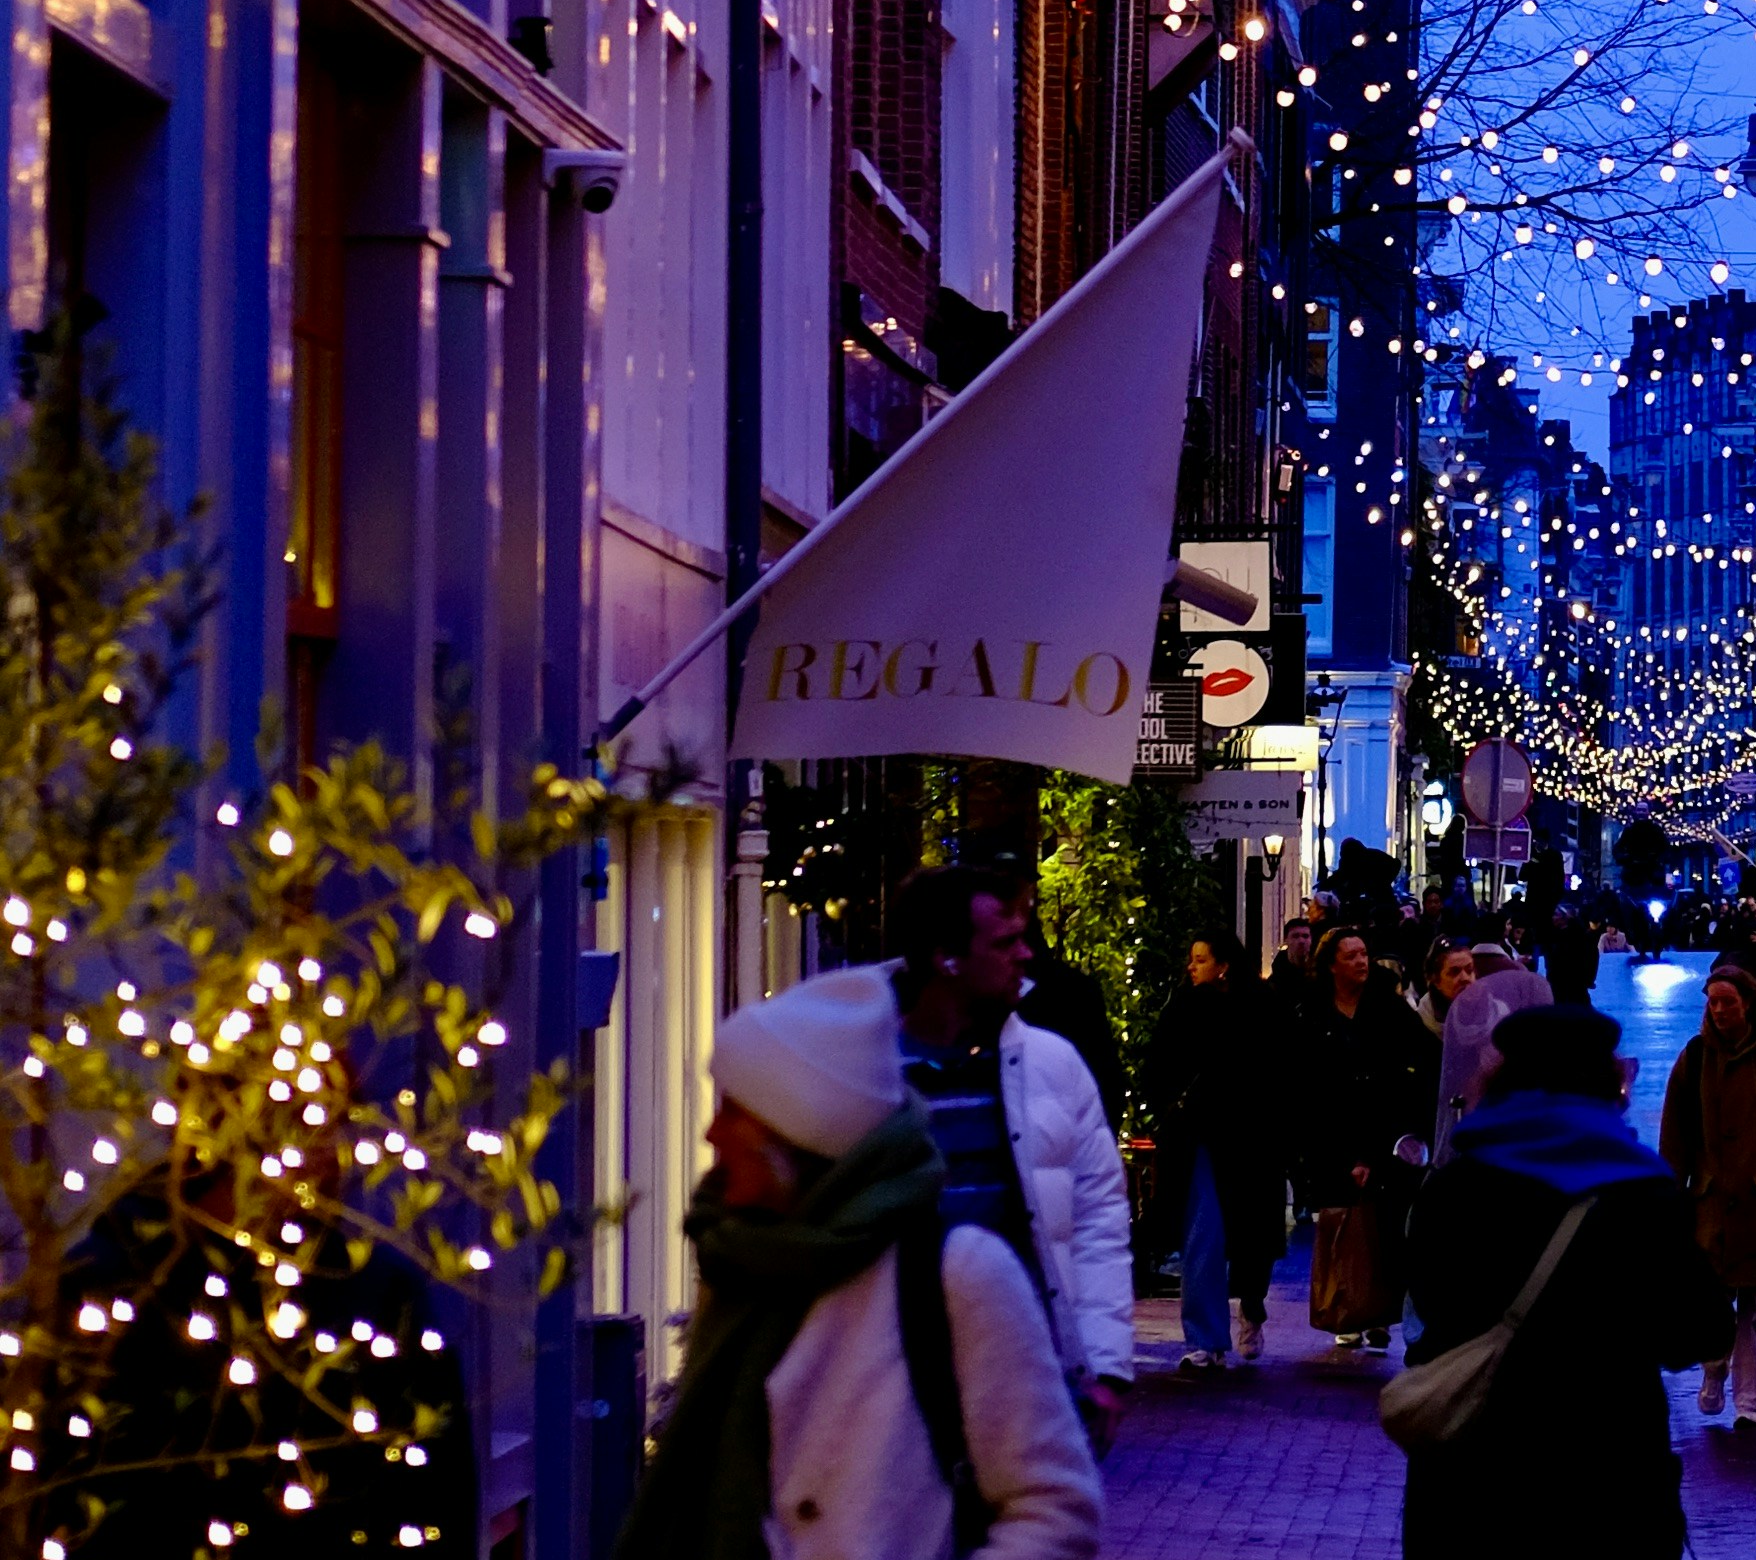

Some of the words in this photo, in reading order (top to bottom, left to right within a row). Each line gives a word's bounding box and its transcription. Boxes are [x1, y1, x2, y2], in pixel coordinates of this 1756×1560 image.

[762, 637, 1131, 718] REGALO
[1143, 692, 1165, 714] HE
[1243, 799, 1254, 810] &
[1258, 799, 1290, 810] SON
